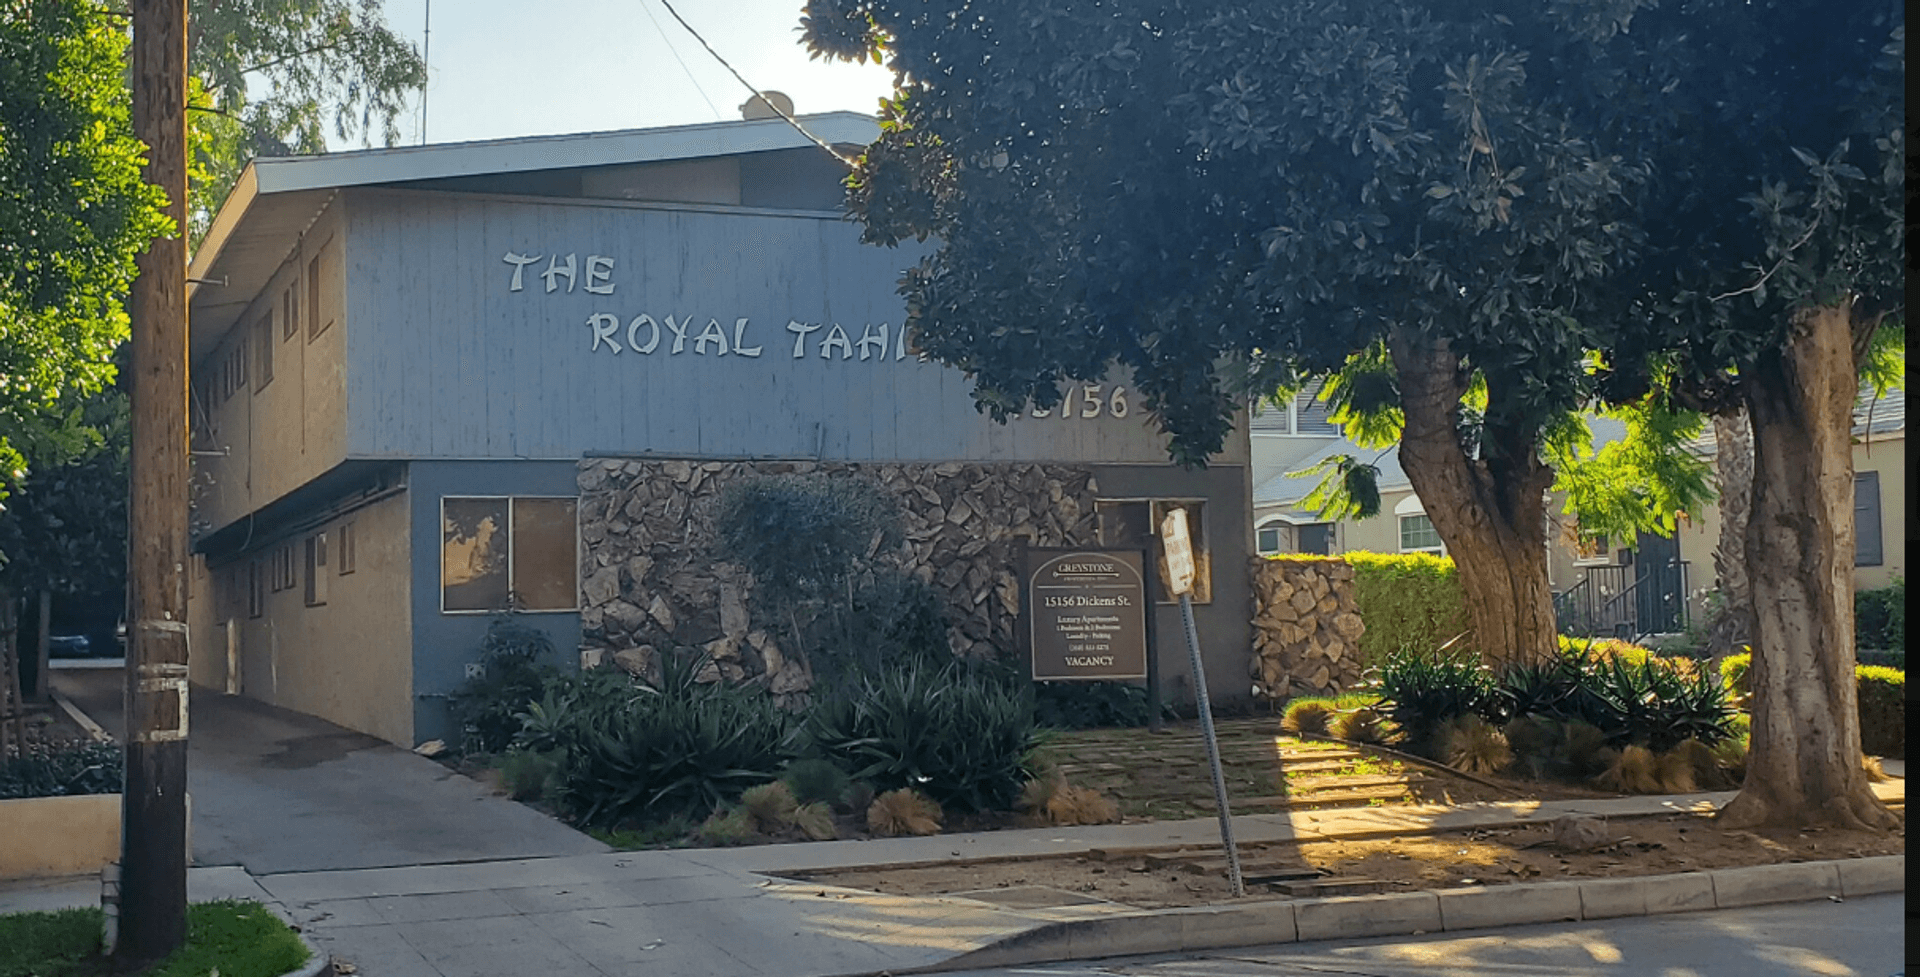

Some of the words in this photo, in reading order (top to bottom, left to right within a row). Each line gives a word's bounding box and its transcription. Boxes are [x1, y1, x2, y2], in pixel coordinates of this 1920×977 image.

[503, 251, 616, 295] THE
[586, 312, 763, 356] ROYAL
[786, 320, 907, 362] TAHI
[1012, 384, 1128, 419] 156
[1058, 563, 1114, 572] GREYSTONE
[1045, 596, 1075, 607] 15156
[1076, 596, 1116, 606] Dickens
[1117, 595, 1131, 606] St.
[1057, 615, 1080, 624] Luxury
[1081, 615, 1119, 624] Apartments
[1065, 656, 1114, 666] VACANCY
